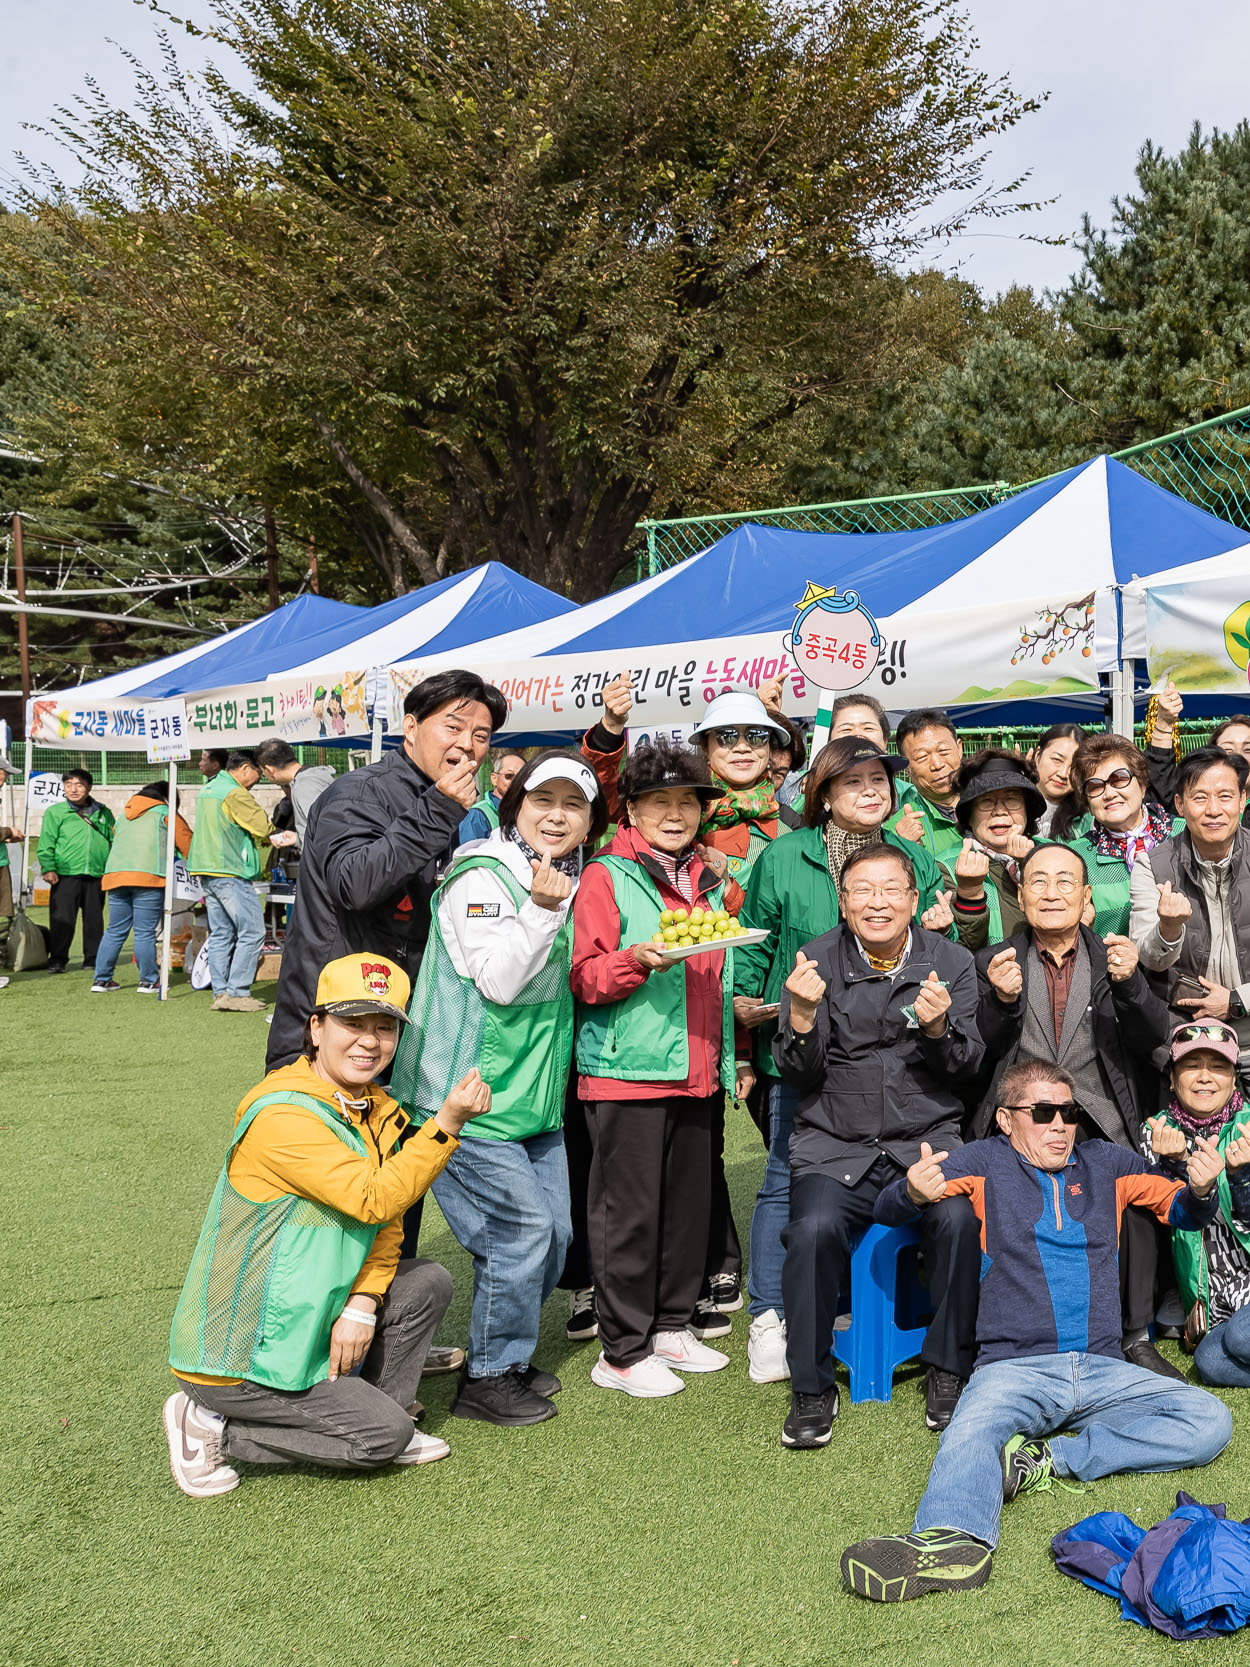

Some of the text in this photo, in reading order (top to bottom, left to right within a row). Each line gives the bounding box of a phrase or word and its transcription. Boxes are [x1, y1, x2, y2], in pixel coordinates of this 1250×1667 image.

[804, 632, 868, 670] 중곡4동
[571, 668, 650, 709] 정감린
[655, 660, 697, 707] 마을
[71, 709, 109, 737] 군자동
[150, 715, 182, 740] 군자동
[361, 963, 392, 980] POP
